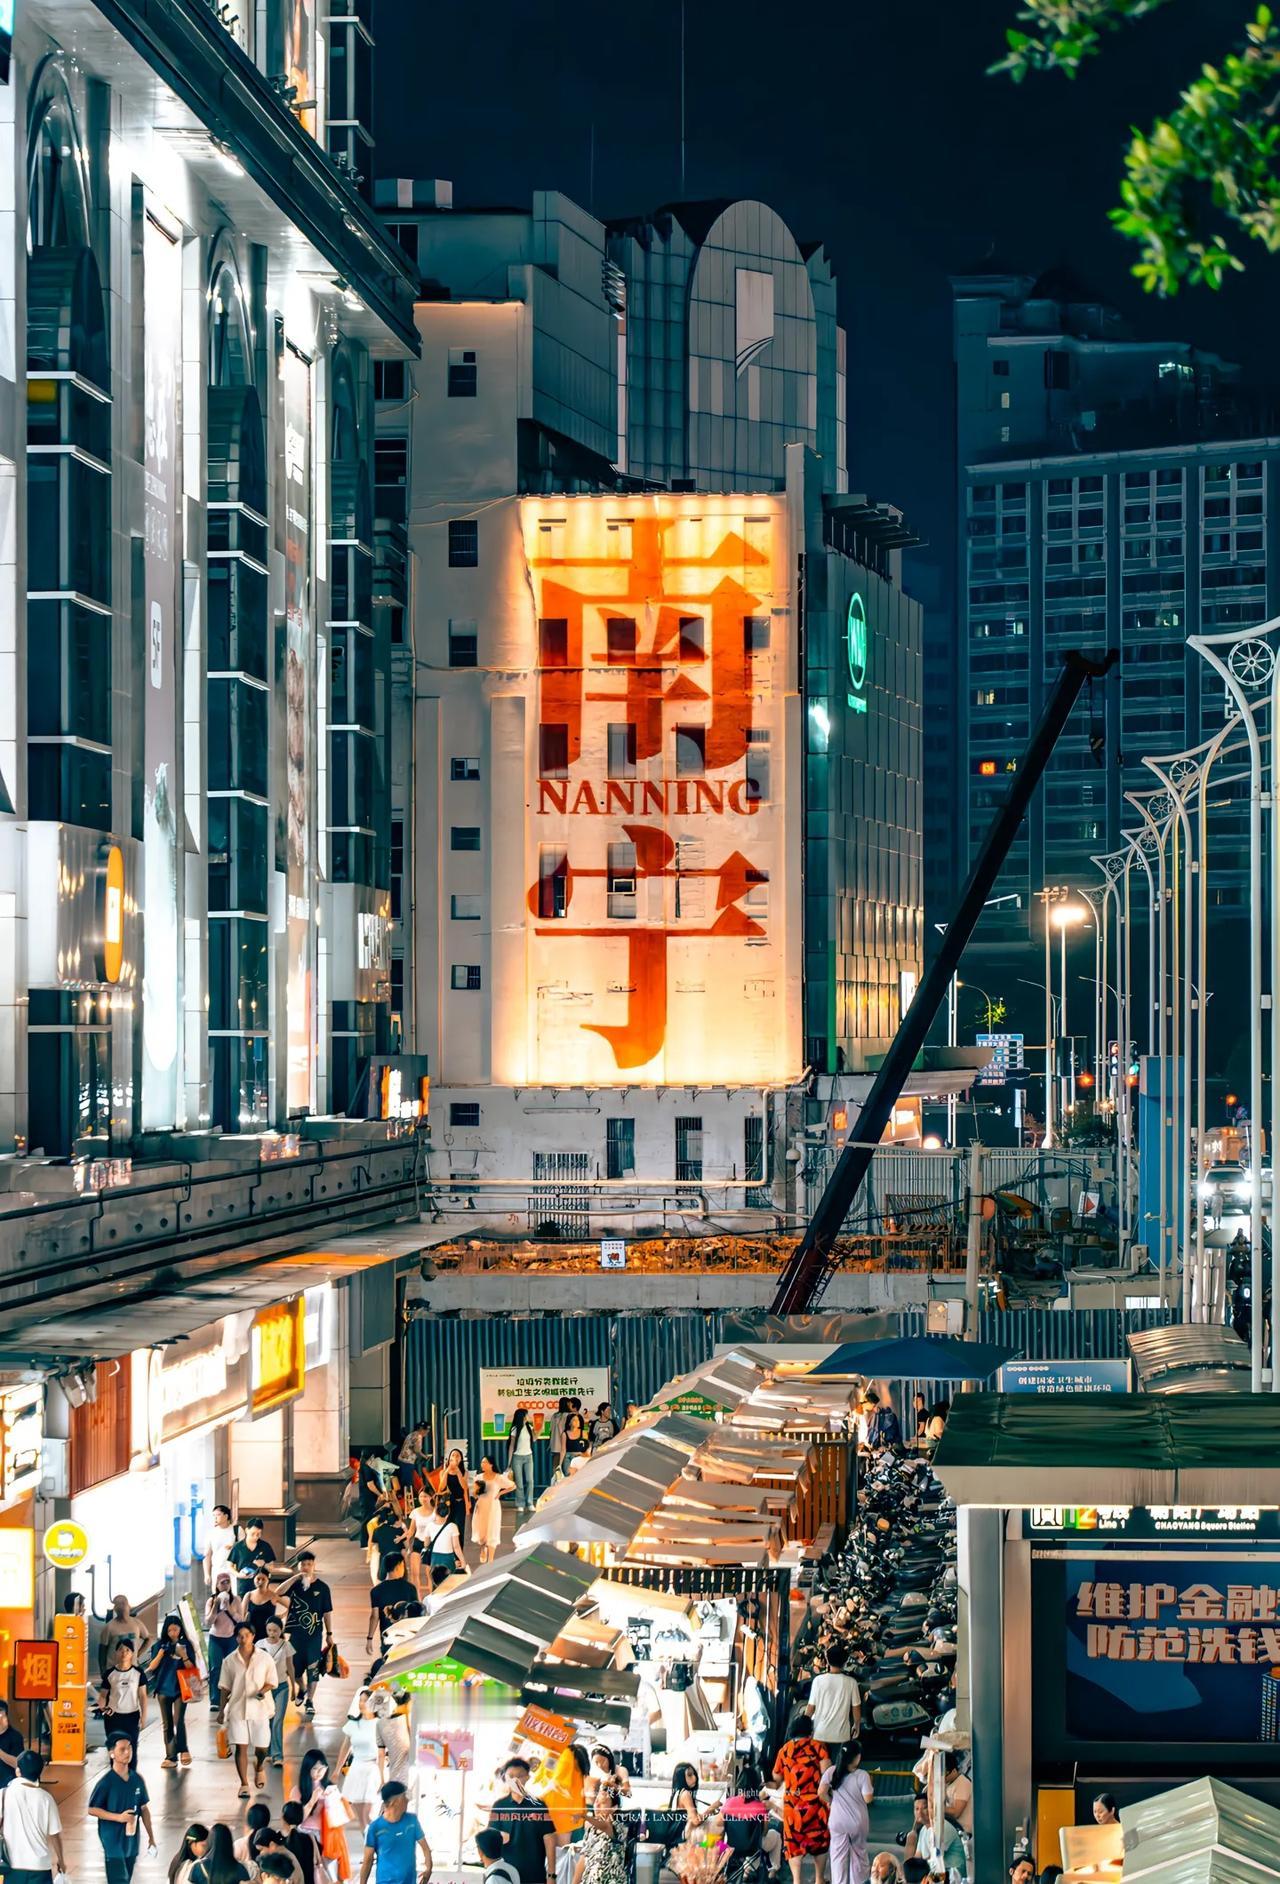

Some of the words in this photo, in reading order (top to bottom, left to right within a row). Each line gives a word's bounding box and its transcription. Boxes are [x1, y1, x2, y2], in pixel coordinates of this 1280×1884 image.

[536, 778, 762, 816] NANNING
[1098, 1519, 1118, 1530] Line
[1120, 1519, 1127, 1530] 1
[1154, 1521, 1201, 1531] CHAOYANG
[1076, 1581, 1280, 1622] 维护金融
[1087, 1623, 1280, 1665] 防范洗钱
[23, 1652, 52, 1687] 烟
